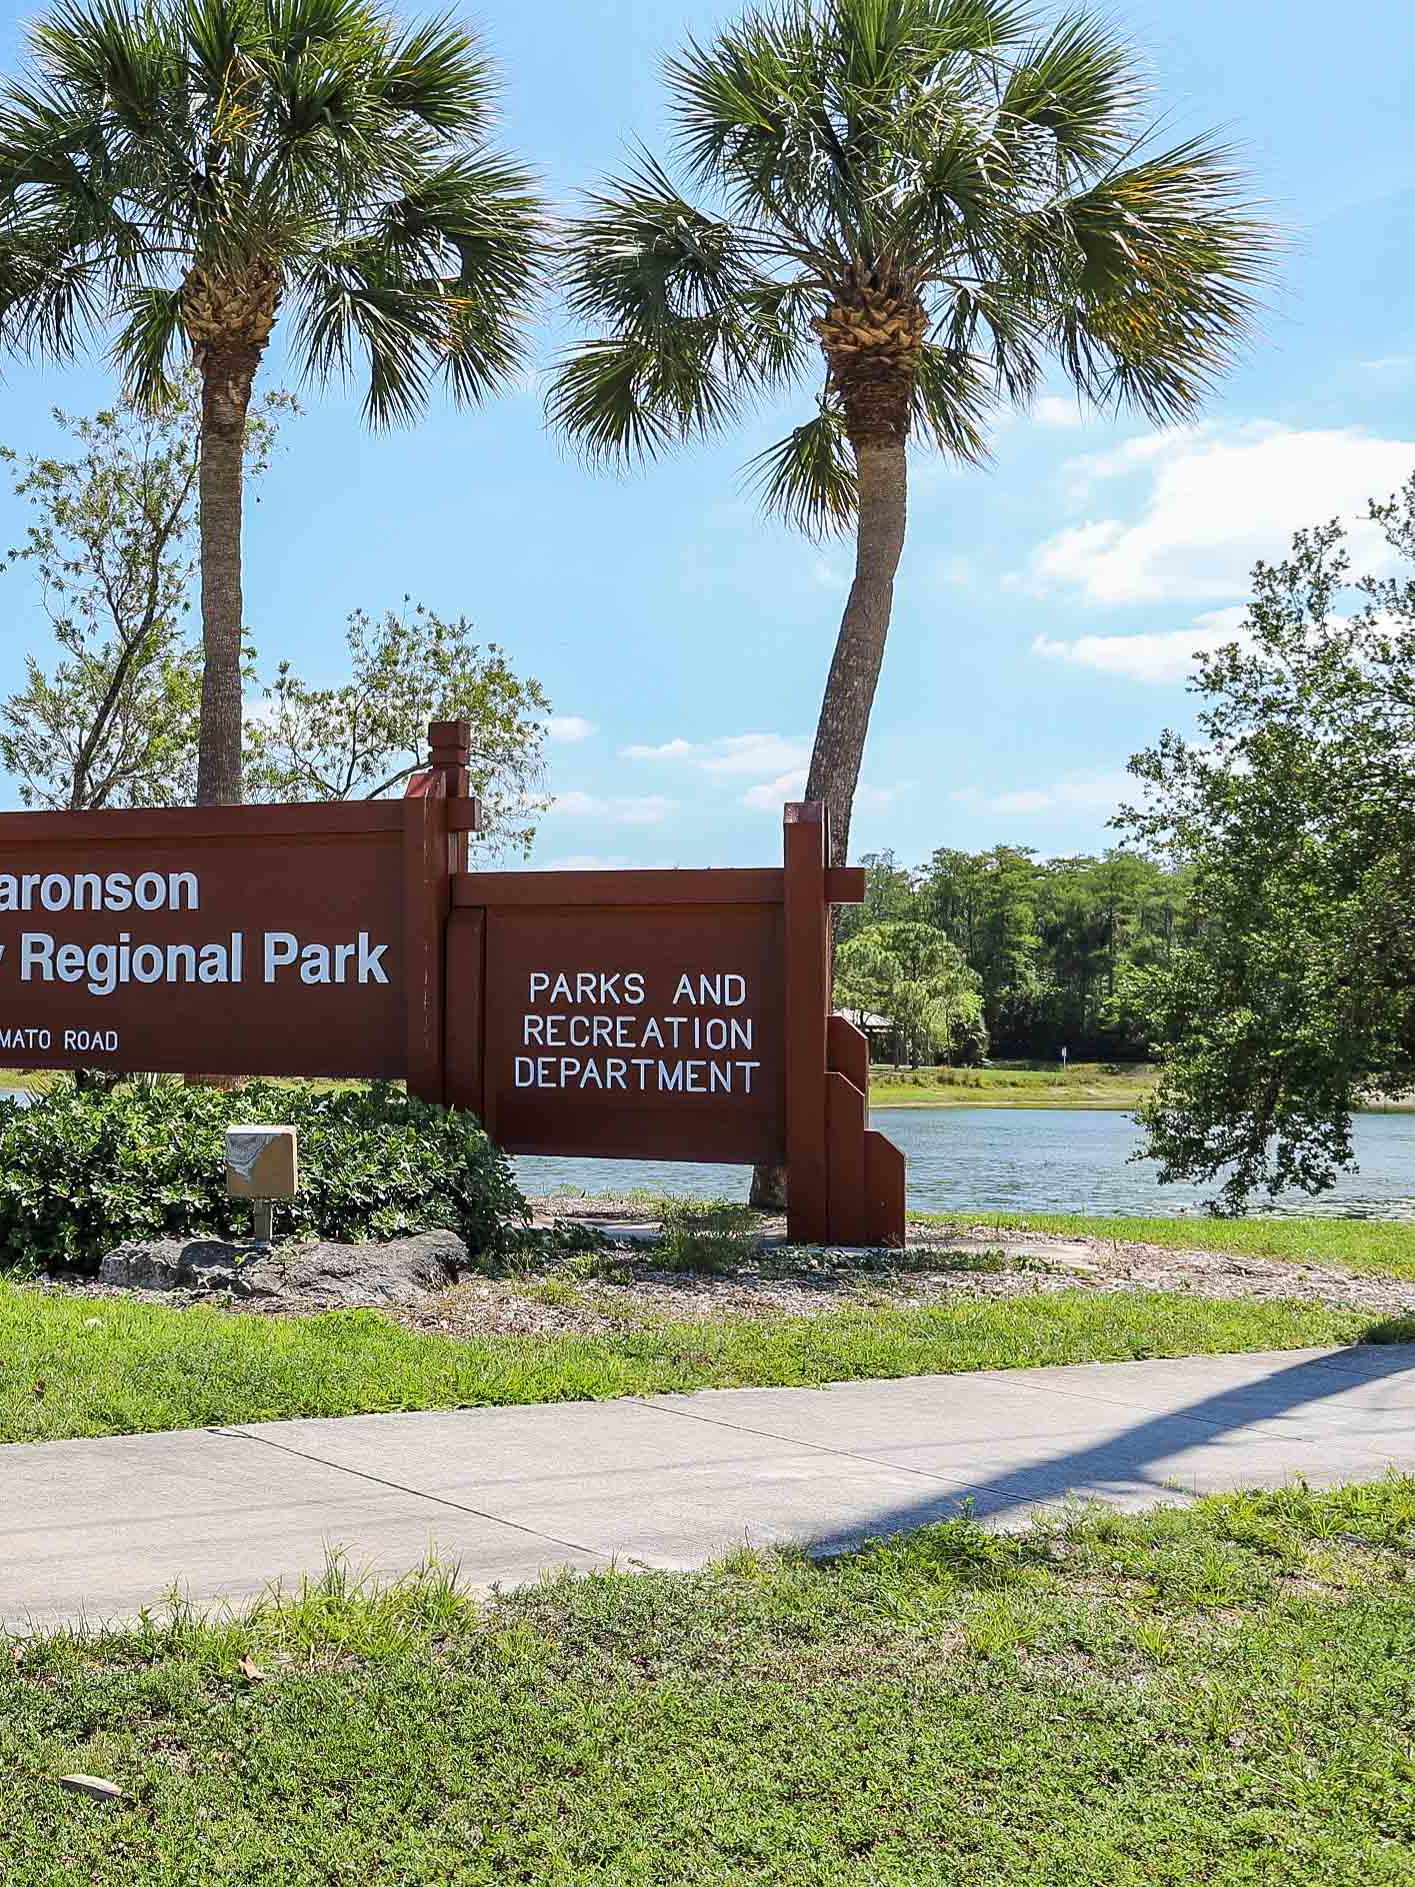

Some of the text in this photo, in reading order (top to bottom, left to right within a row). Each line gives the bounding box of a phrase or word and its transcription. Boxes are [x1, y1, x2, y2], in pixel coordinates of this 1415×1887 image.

[21, 933, 242, 995] Regional
[265, 932, 389, 984] Park
[531, 973, 745, 1006] PARKS AND
[65, 1030, 117, 1051] ROAD
[525, 1015, 751, 1050] RECREATION
[516, 1057, 760, 1093] DEPARTMENT
